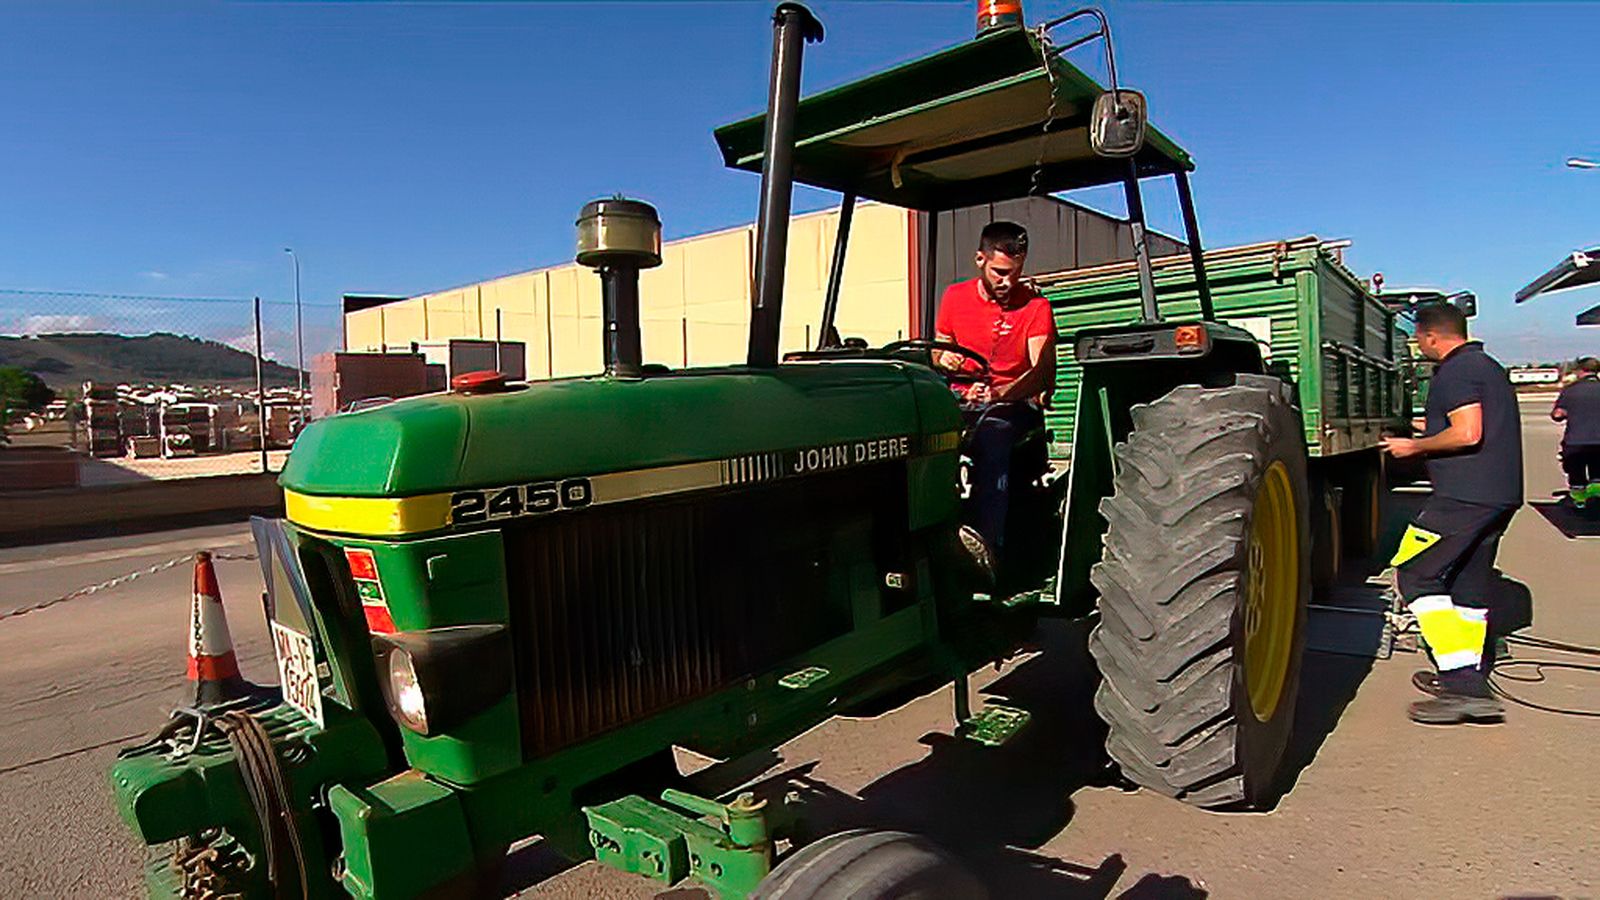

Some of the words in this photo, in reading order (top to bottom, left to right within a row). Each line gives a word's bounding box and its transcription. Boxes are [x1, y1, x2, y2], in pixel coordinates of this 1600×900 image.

[794, 445, 848, 472] JOHN
[855, 437, 908, 462] DEERE
[451, 478, 592, 524] 2450
